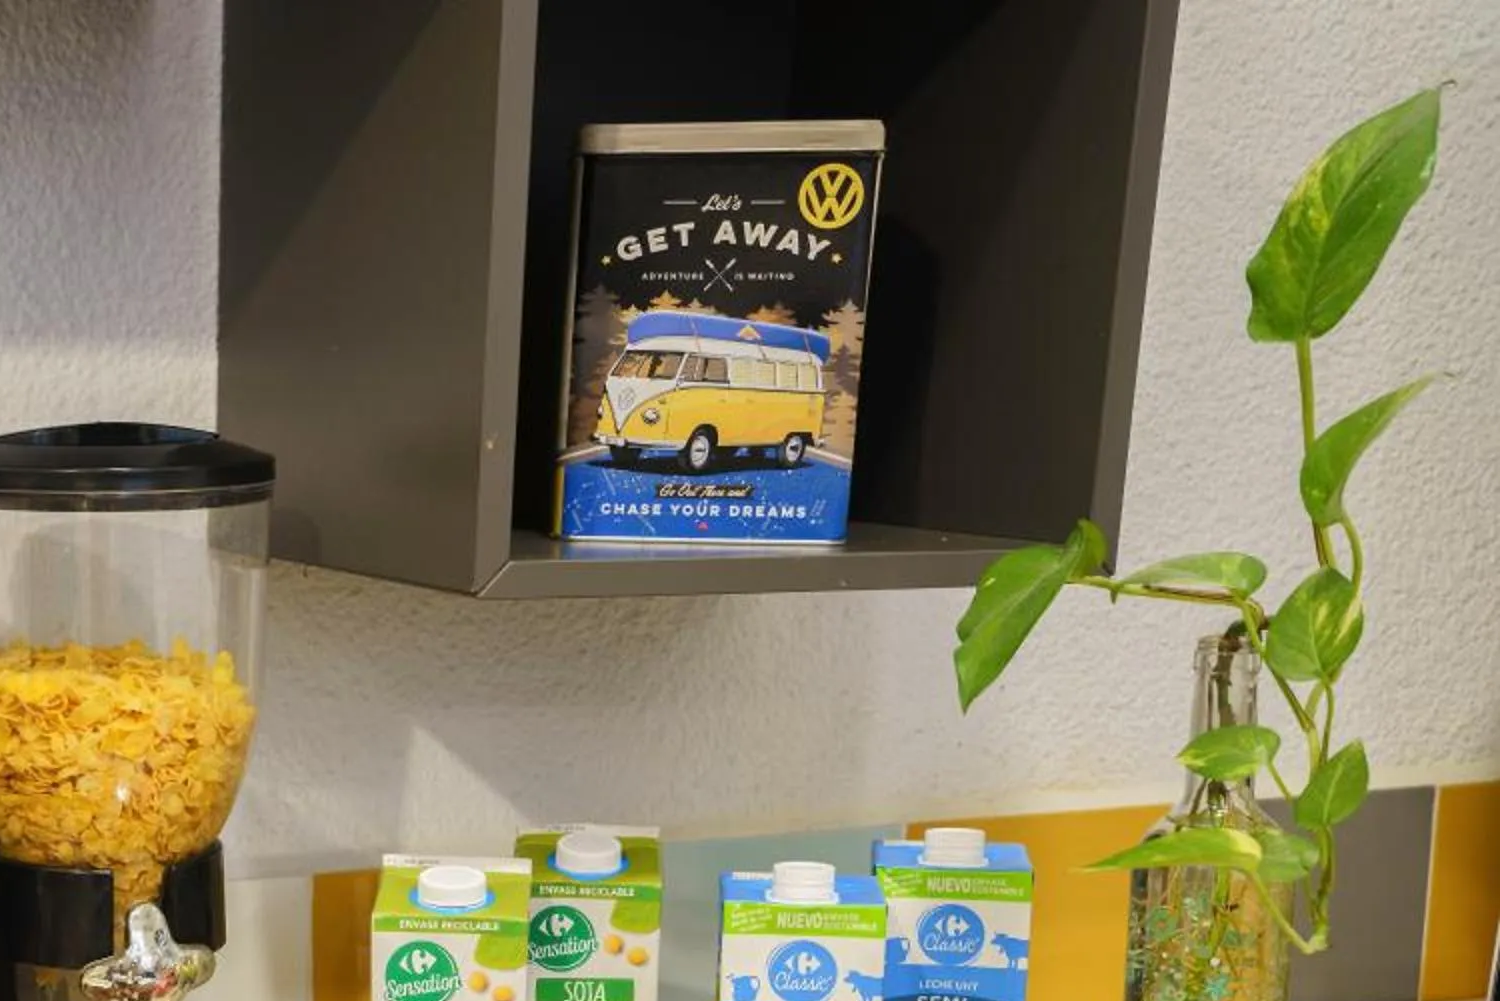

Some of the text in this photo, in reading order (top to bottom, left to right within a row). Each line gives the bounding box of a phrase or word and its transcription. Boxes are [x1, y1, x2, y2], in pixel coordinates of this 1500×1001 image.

[616, 219, 832, 261] GET AWAY
[640, 271, 705, 281] ADVENTURE
[747, 271, 796, 281] WAITING
[600, 503, 808, 519] CHASE YOUR DREAMS
[926, 876, 971, 893] NUEVO
[776, 911, 823, 929] NUEVO
[529, 936, 598, 958] Sensation
[923, 933, 977, 953] Classic
[385, 973, 462, 1001] Sensation
[773, 972, 831, 992] Classic
[919, 979, 980, 991] LECHE UHT
